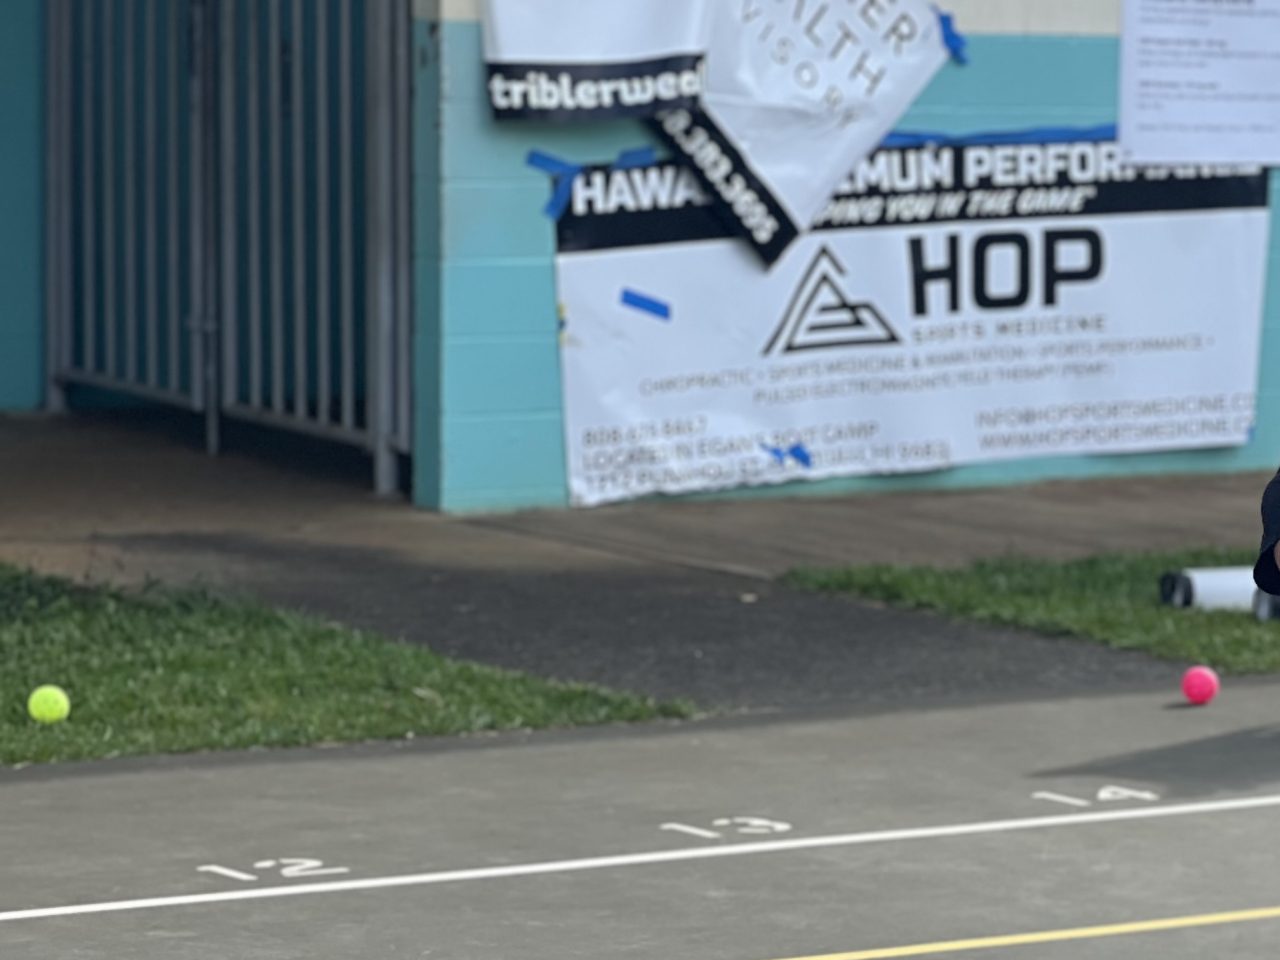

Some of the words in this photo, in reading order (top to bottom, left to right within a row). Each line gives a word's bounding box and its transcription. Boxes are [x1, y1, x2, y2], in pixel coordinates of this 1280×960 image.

[966, 187, 1018, 218] THE
[908, 226, 1104, 318] HOP
[996, 313, 1106, 336] MEDICINE
[195, 857, 350, 881] 12
